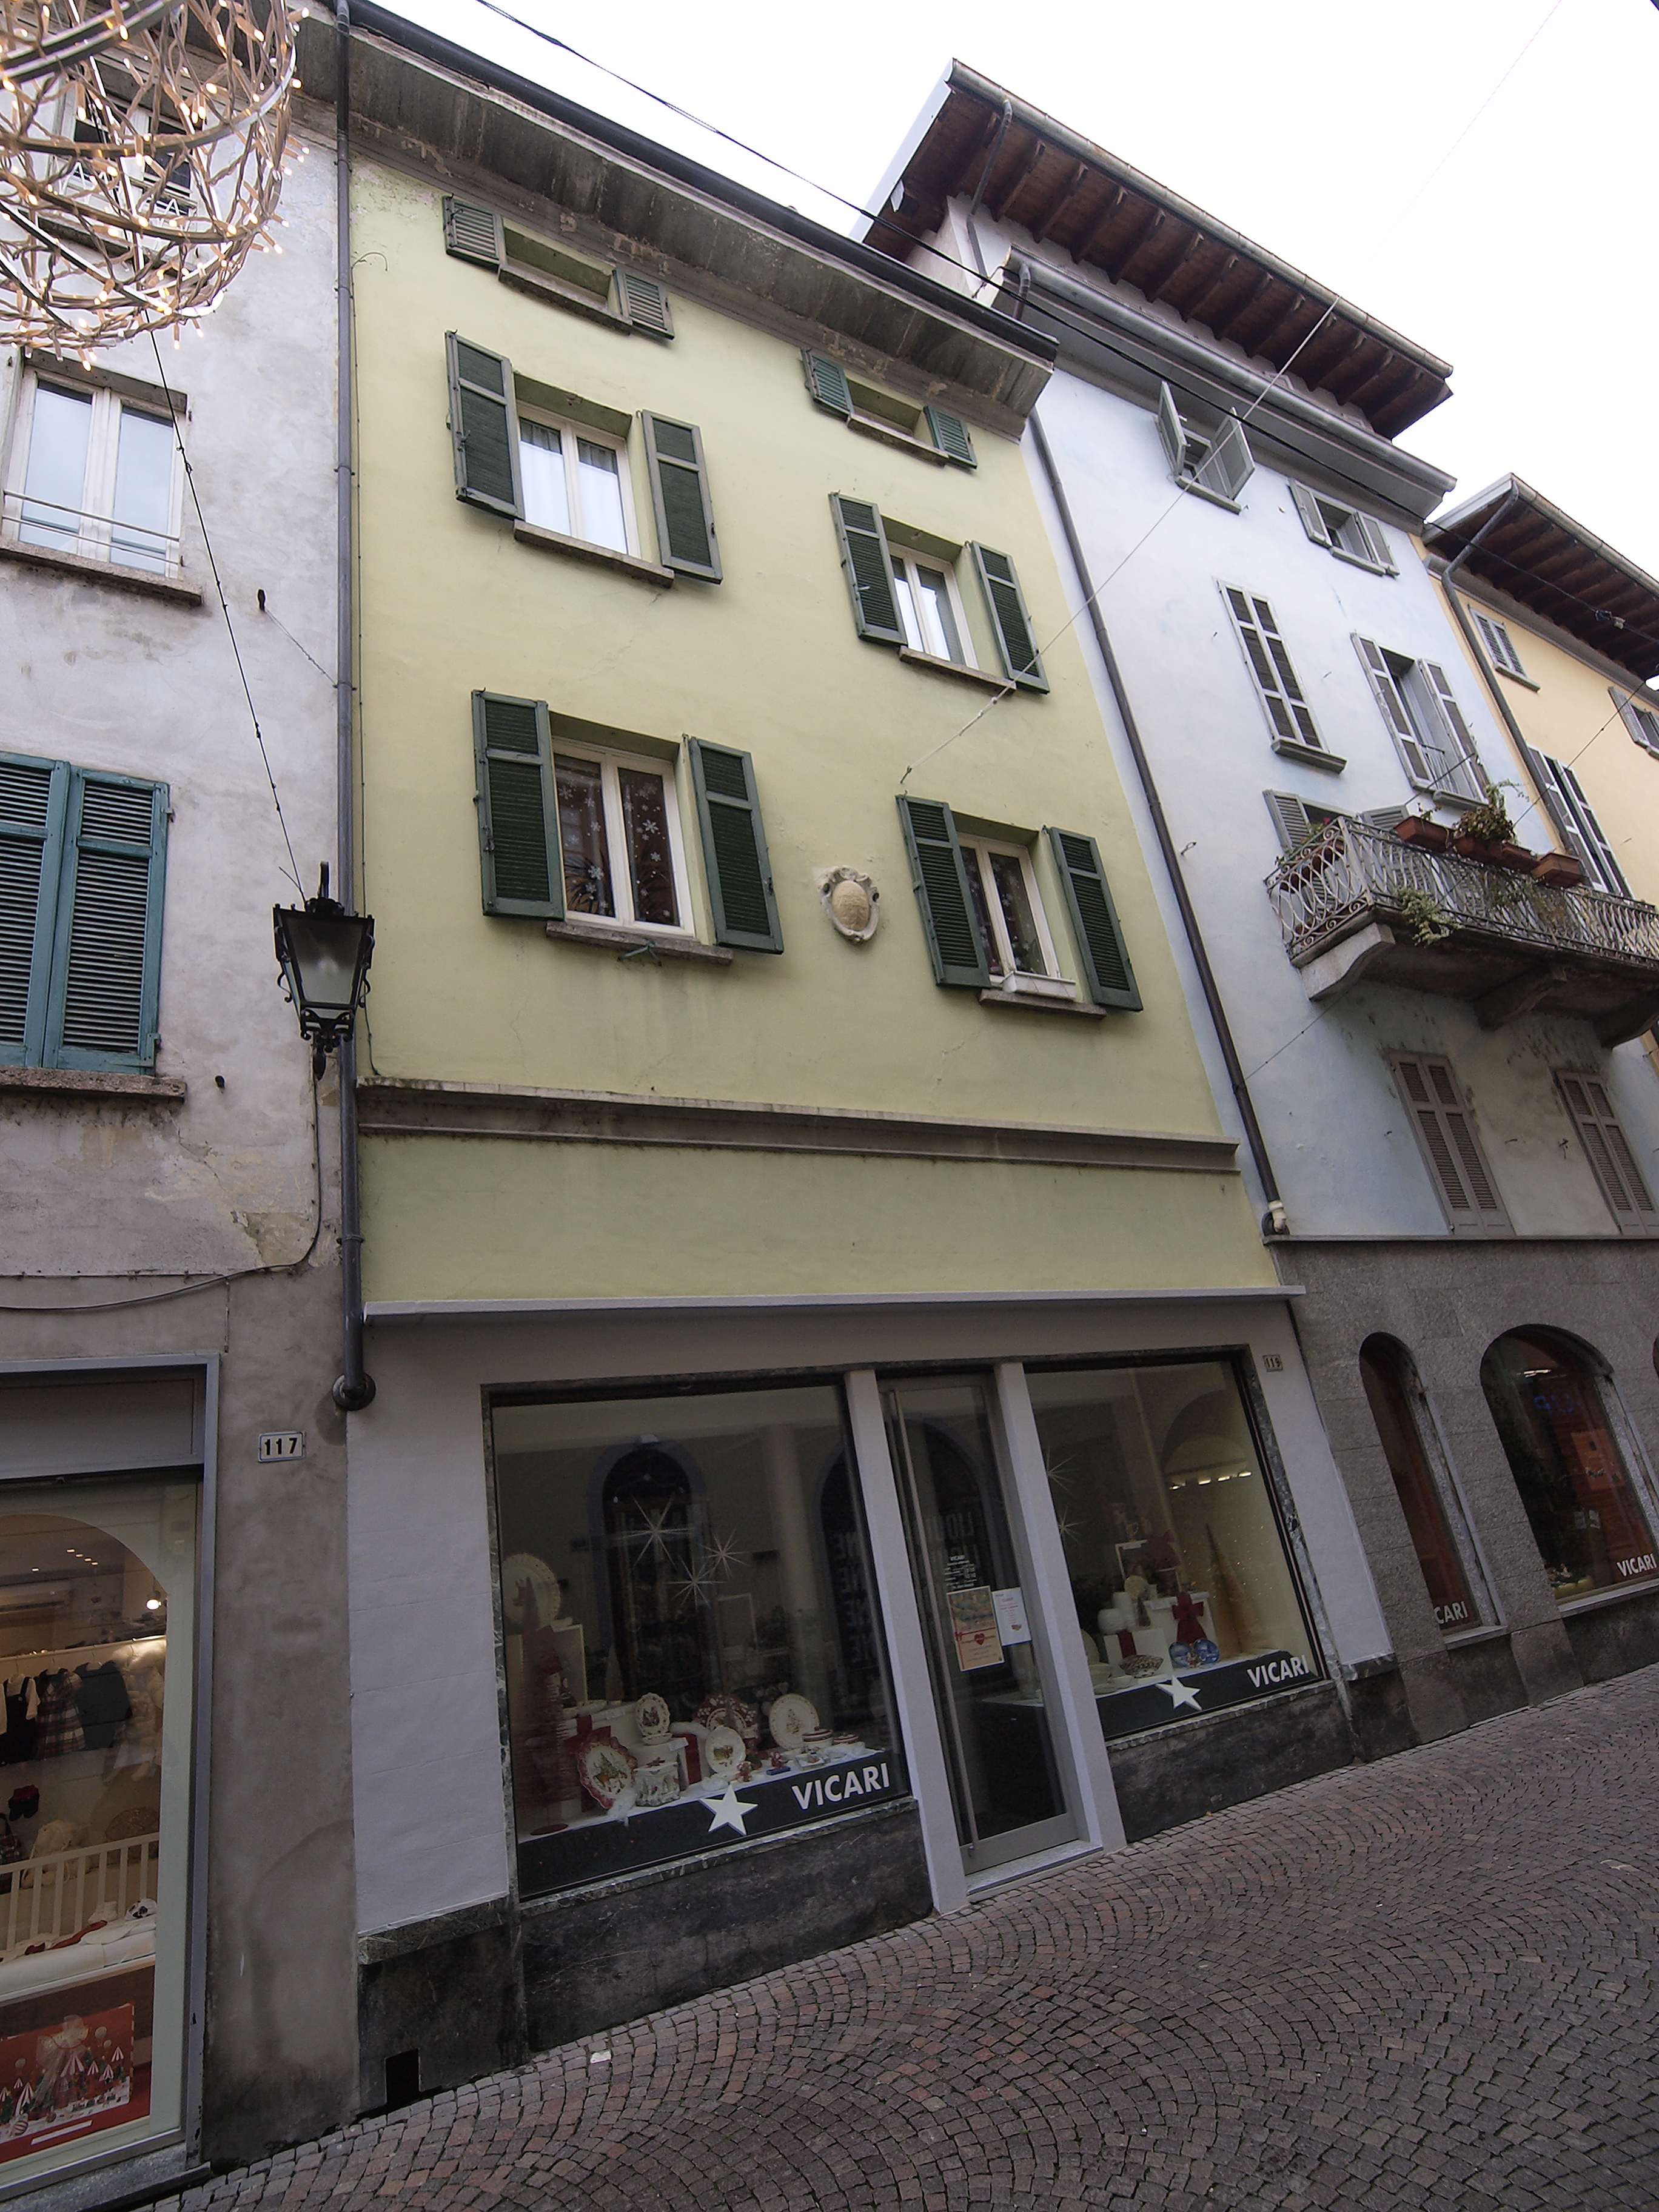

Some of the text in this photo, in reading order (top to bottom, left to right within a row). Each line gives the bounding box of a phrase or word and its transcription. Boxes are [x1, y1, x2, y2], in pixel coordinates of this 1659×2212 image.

[1265, 1357, 1280, 1368] 119
[264, 1438, 298, 1455] 117
[1616, 1553, 1657, 1577] VICARI
[1247, 1654, 1310, 1687] VICARI
[791, 1763, 890, 1810] VICARI
